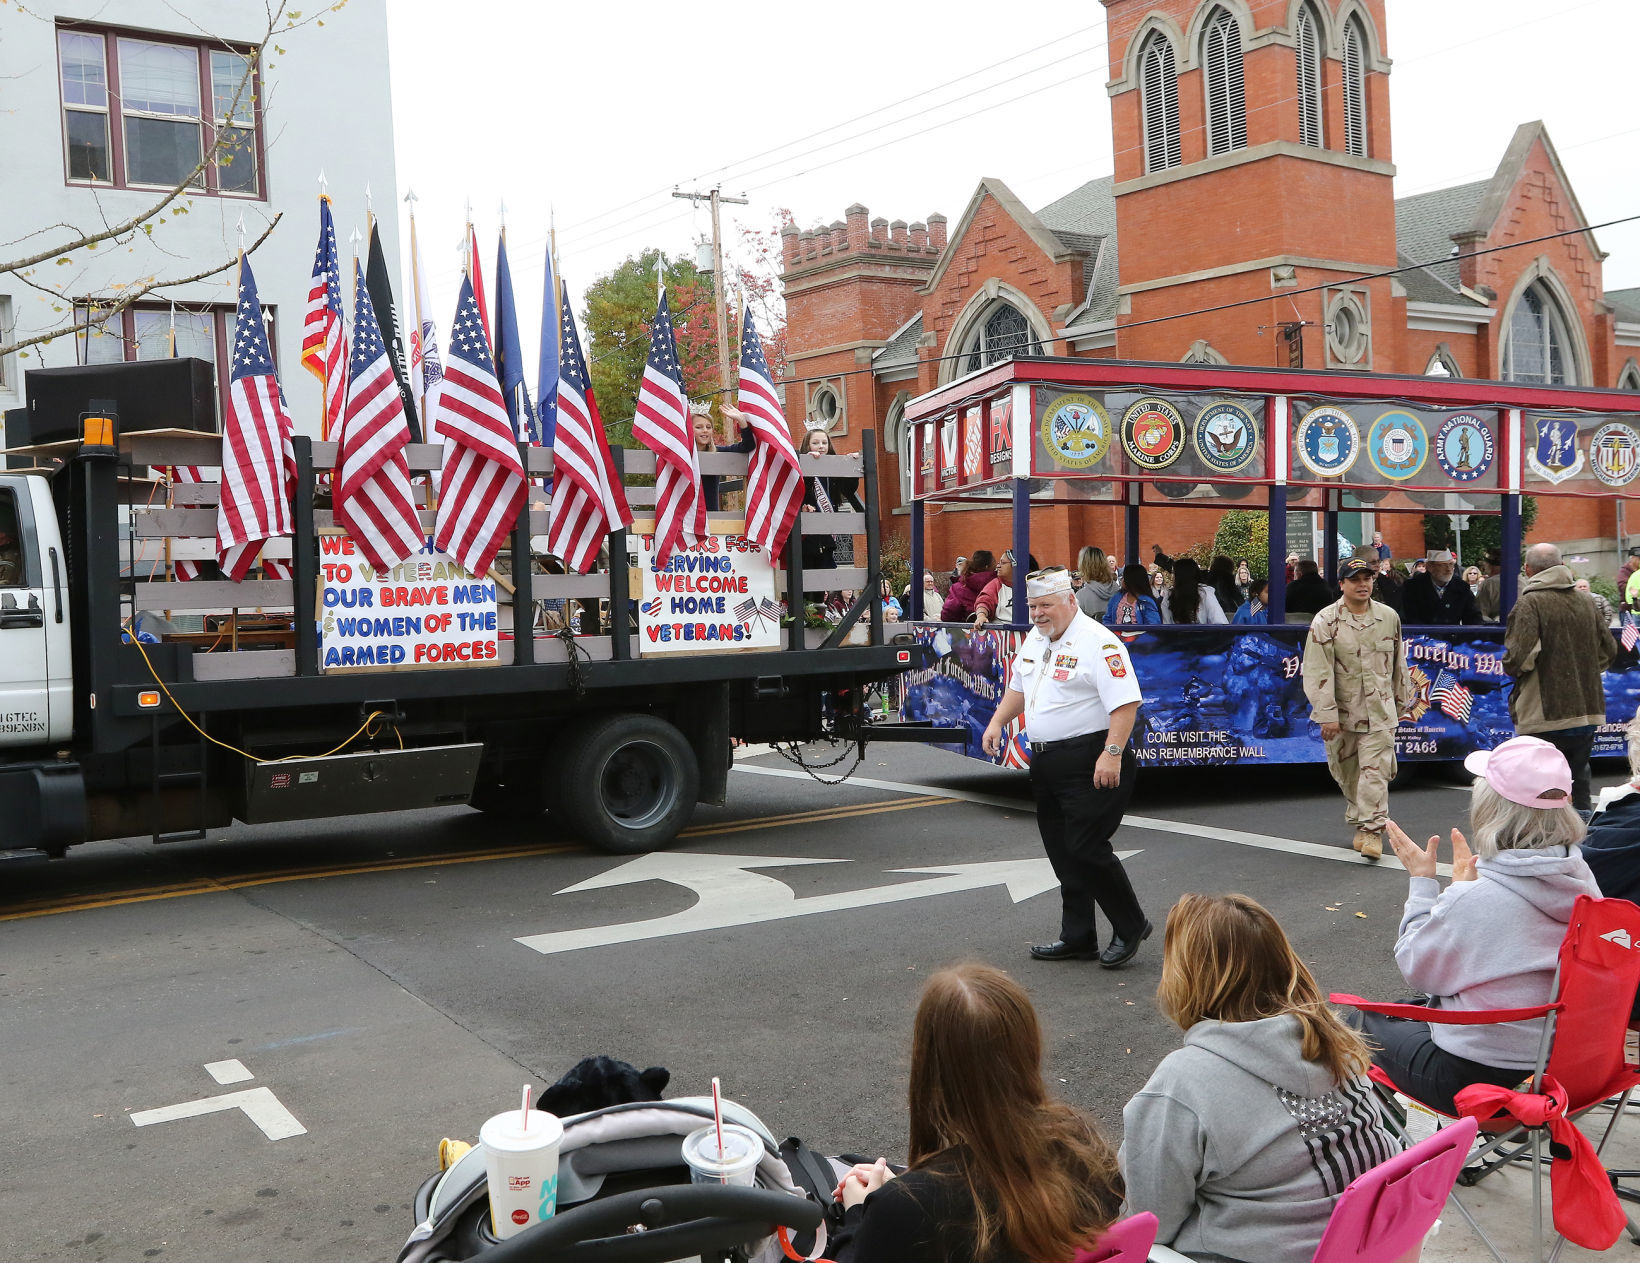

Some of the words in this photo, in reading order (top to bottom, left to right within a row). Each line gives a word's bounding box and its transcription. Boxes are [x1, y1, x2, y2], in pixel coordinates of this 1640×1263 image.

[1128, 403, 1150, 424] UNITED
[1156, 403, 1178, 425] STATES
[1198, 406, 1224, 433] DEPARTMENT
[1234, 409, 1244, 420] THE
[990, 403, 1012, 453] FX
[1436, 433, 1445, 460] ARMY
[1442, 415, 1481, 433] NATIONAL
[1480, 427, 1493, 461] GUARD
[1592, 425, 1611, 447] UNITED
[990, 449, 1012, 464] DESIGNS
[1128, 440, 1155, 463] MARINE
[1159, 440, 1180, 462] CORPS
[1198, 438, 1210, 459] UNITED
[1209, 456, 1228, 467] STATES
[321, 535, 355, 556] WE
[641, 534, 719, 553] TKS
[725, 535, 761, 553] FOR
[321, 563, 352, 583] TO
[651, 552, 736, 574] SERVING,
[655, 573, 749, 593] WELCOME
[323, 587, 374, 608] OUR
[379, 585, 449, 607] BRAVE
[452, 584, 496, 605] MEN
[670, 596, 726, 615] HOME
[336, 616, 422, 637] WOMEN
[424, 613, 452, 634] OF
[456, 611, 497, 632] THE
[646, 622, 752, 643] VETERANS!
[324, 644, 406, 666] ARMED
[413, 640, 497, 663] FORCES
[1402, 637, 1470, 671] Foreign
[908, 664, 938, 687] Veterans
[936, 656, 943, 675] of
[944, 656, 973, 689] Foreign
[973, 673, 995, 701] Wars
[1147, 731, 1178, 744] COME
[1179, 731, 1207, 743] VISIT
[1208, 730, 1228, 742] THE
[1405, 739, 1438, 754] 2468
[1159, 747, 1237, 760] REMEMBRANCE
[1239, 746, 1266, 758] WALL
